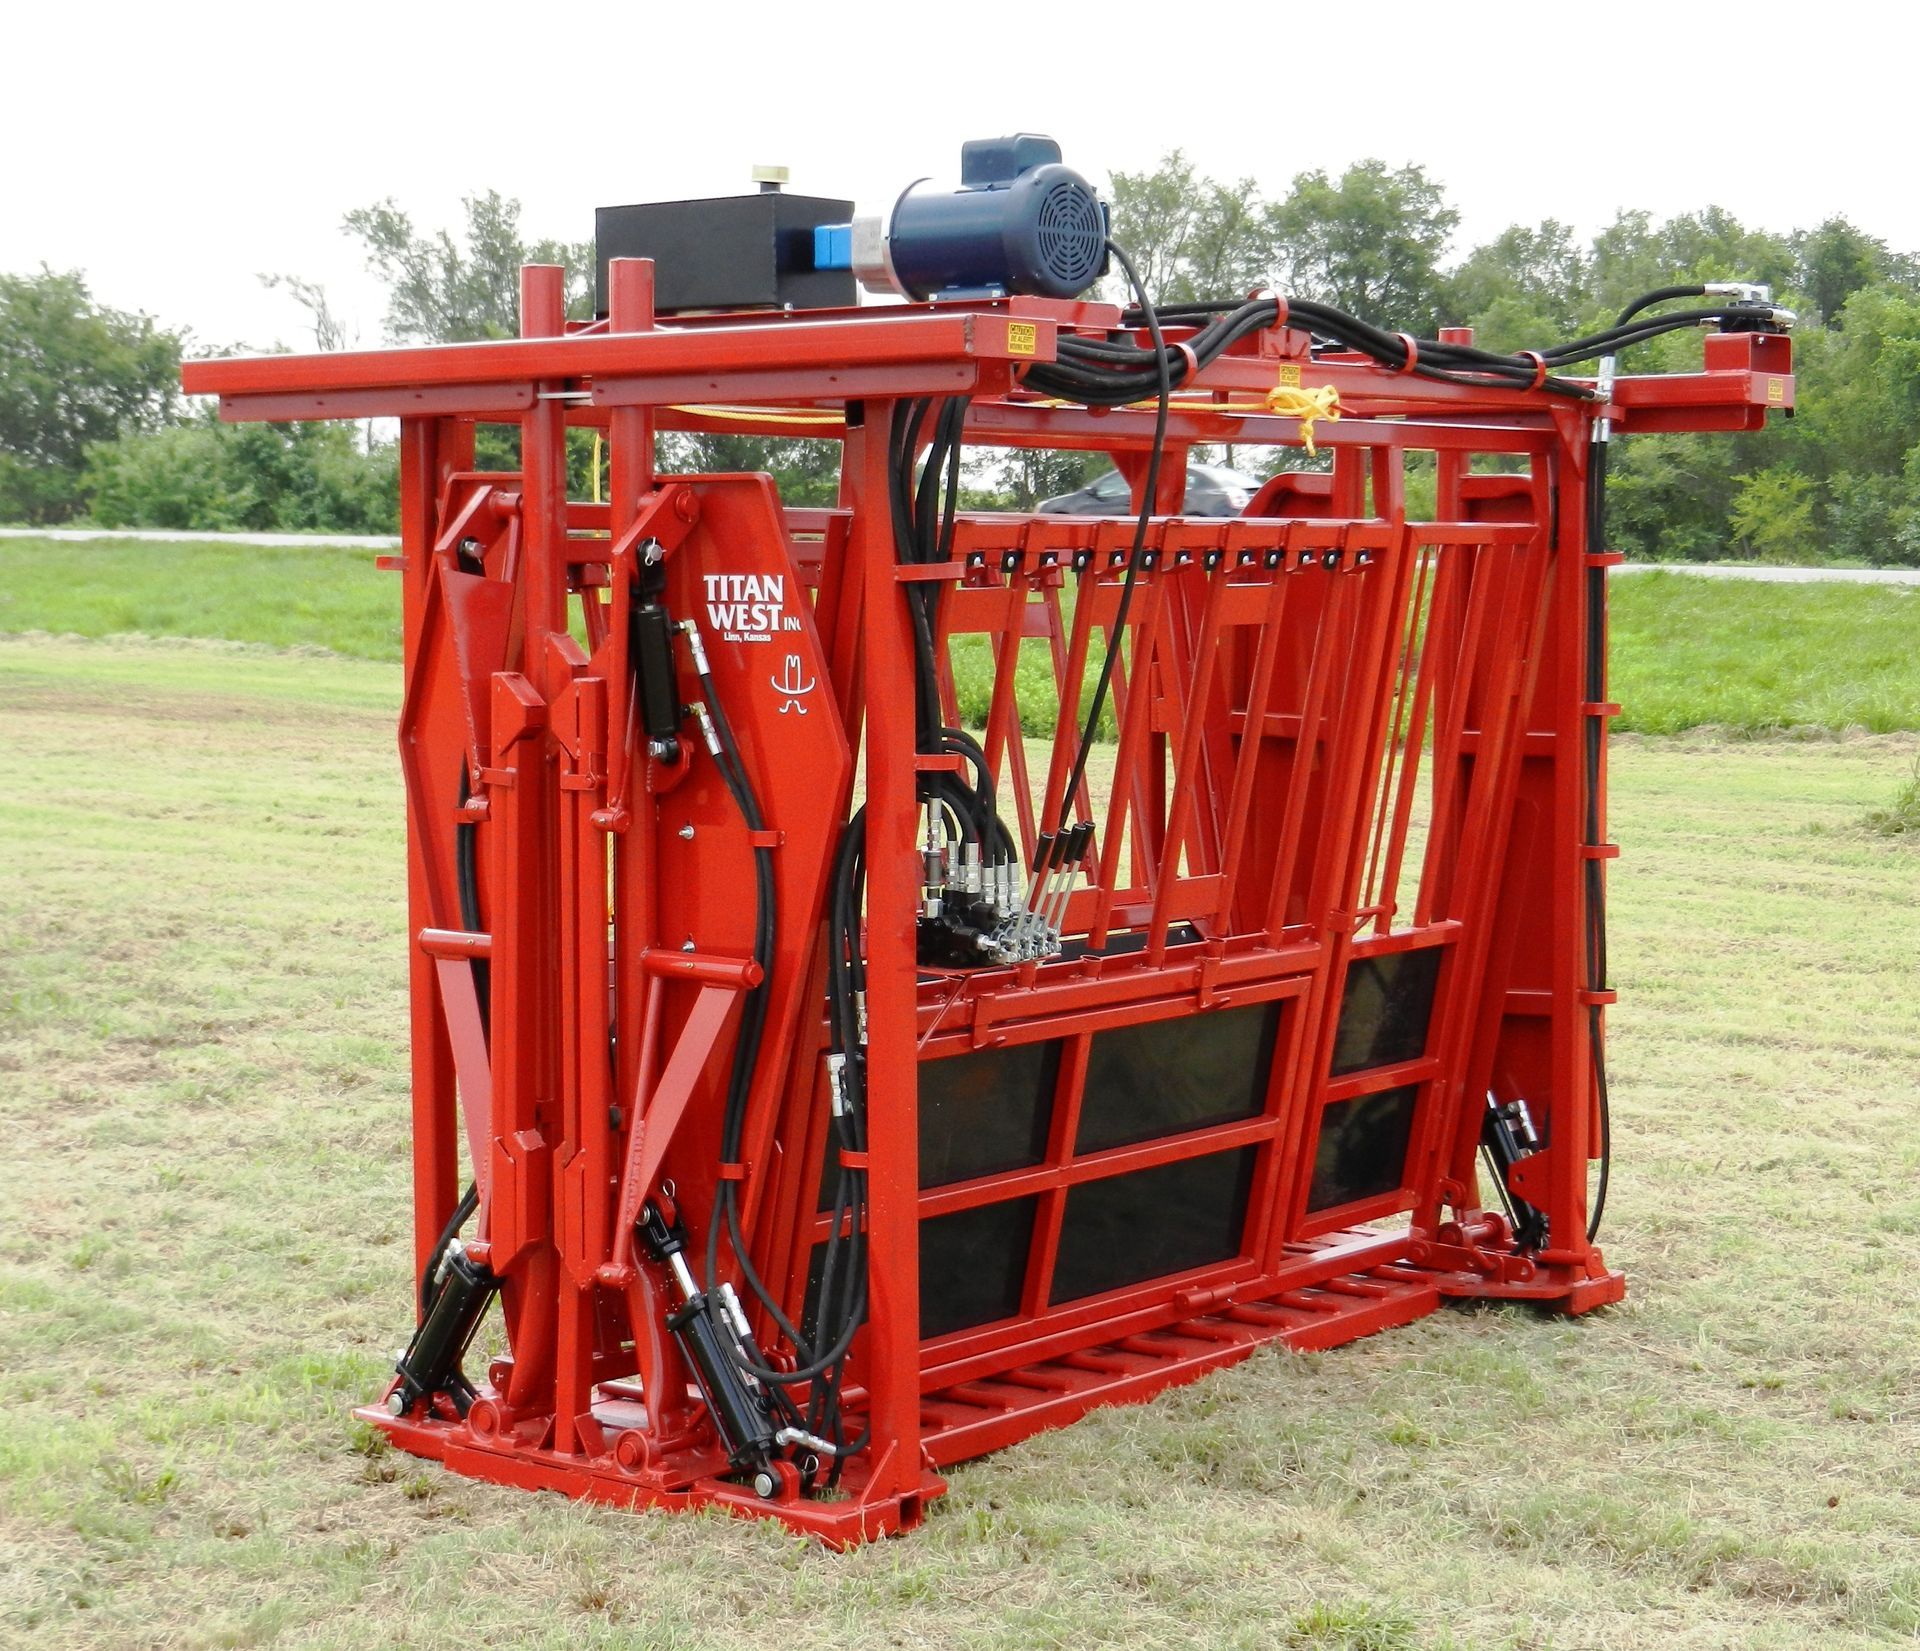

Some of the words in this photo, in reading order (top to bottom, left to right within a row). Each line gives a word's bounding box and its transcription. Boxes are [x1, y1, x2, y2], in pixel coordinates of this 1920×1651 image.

[703, 575, 783, 602] TITAN
[706, 604, 783, 631] WEST
[743, 632, 771, 642] Kansas
